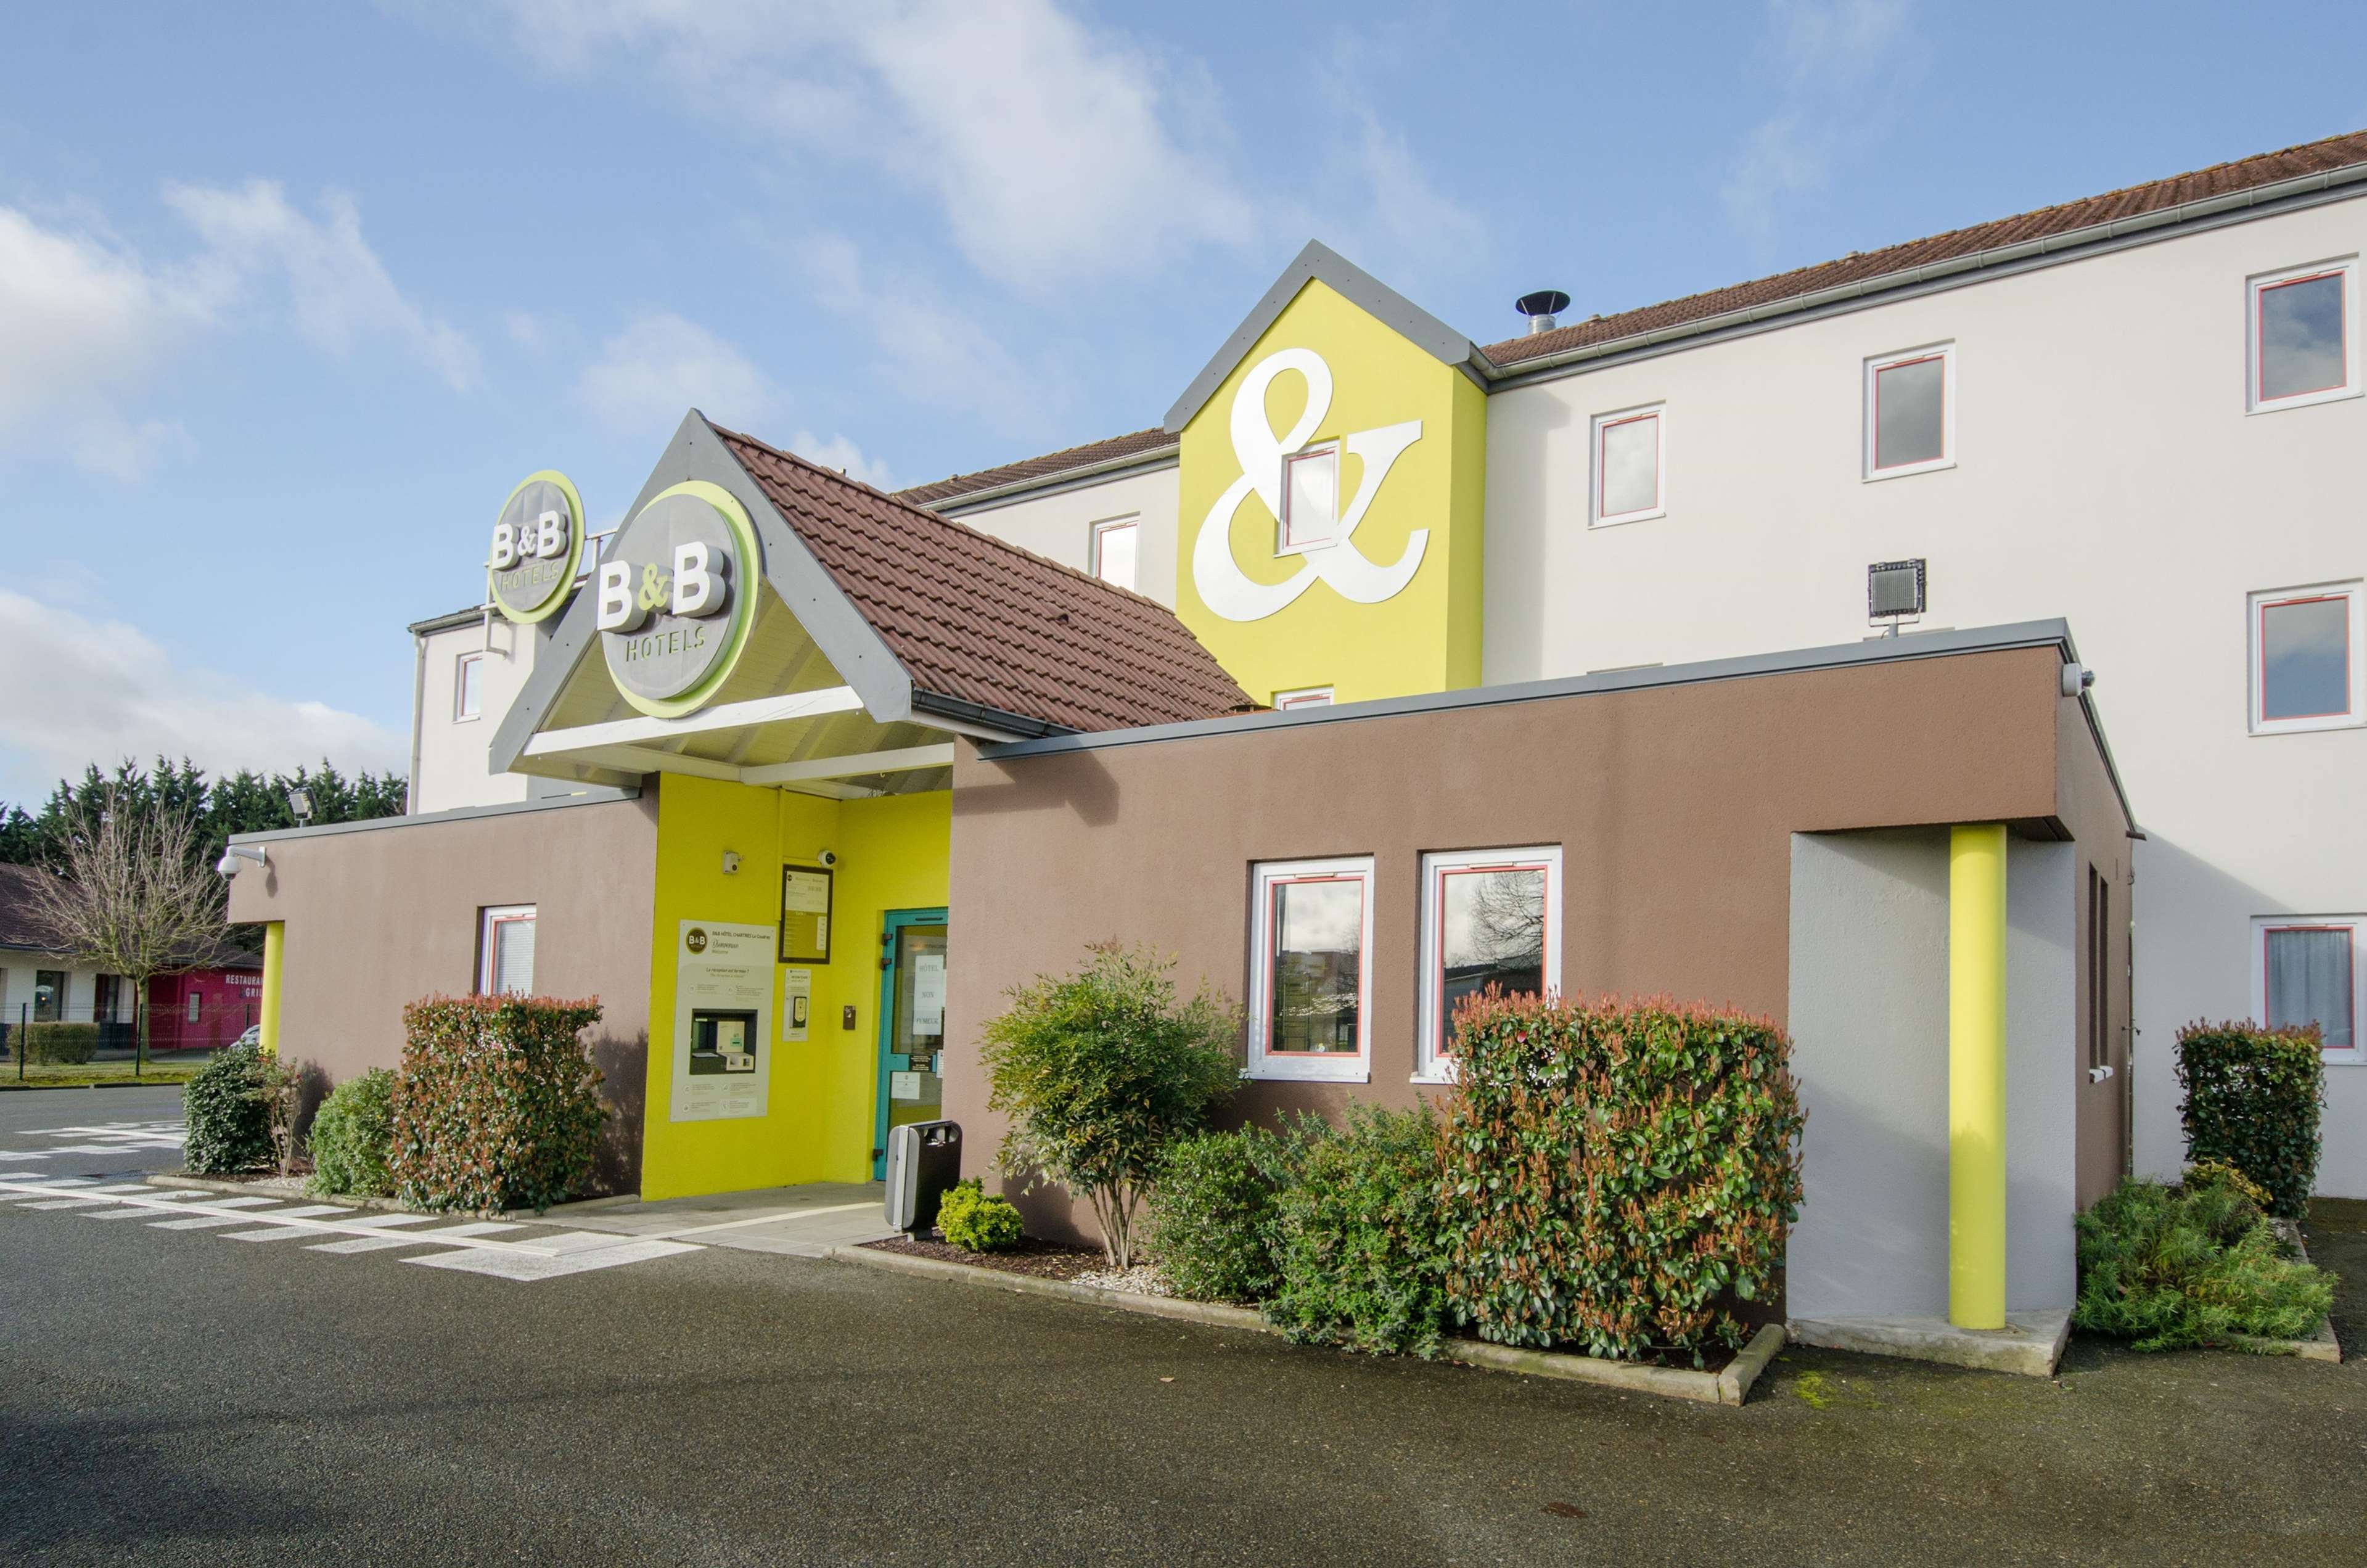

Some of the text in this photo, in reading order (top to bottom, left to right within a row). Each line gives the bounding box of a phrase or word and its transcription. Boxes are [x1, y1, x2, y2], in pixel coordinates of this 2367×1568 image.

[1193, 348, 1430, 622] &
[492, 510, 566, 570] B&B
[501, 562, 559, 591] HOTELS
[597, 541, 726, 633] B&B
[626, 626, 705, 662] HOTELS
[688, 935, 706, 945] B&B
[919, 963, 939, 972] HÔTEL
